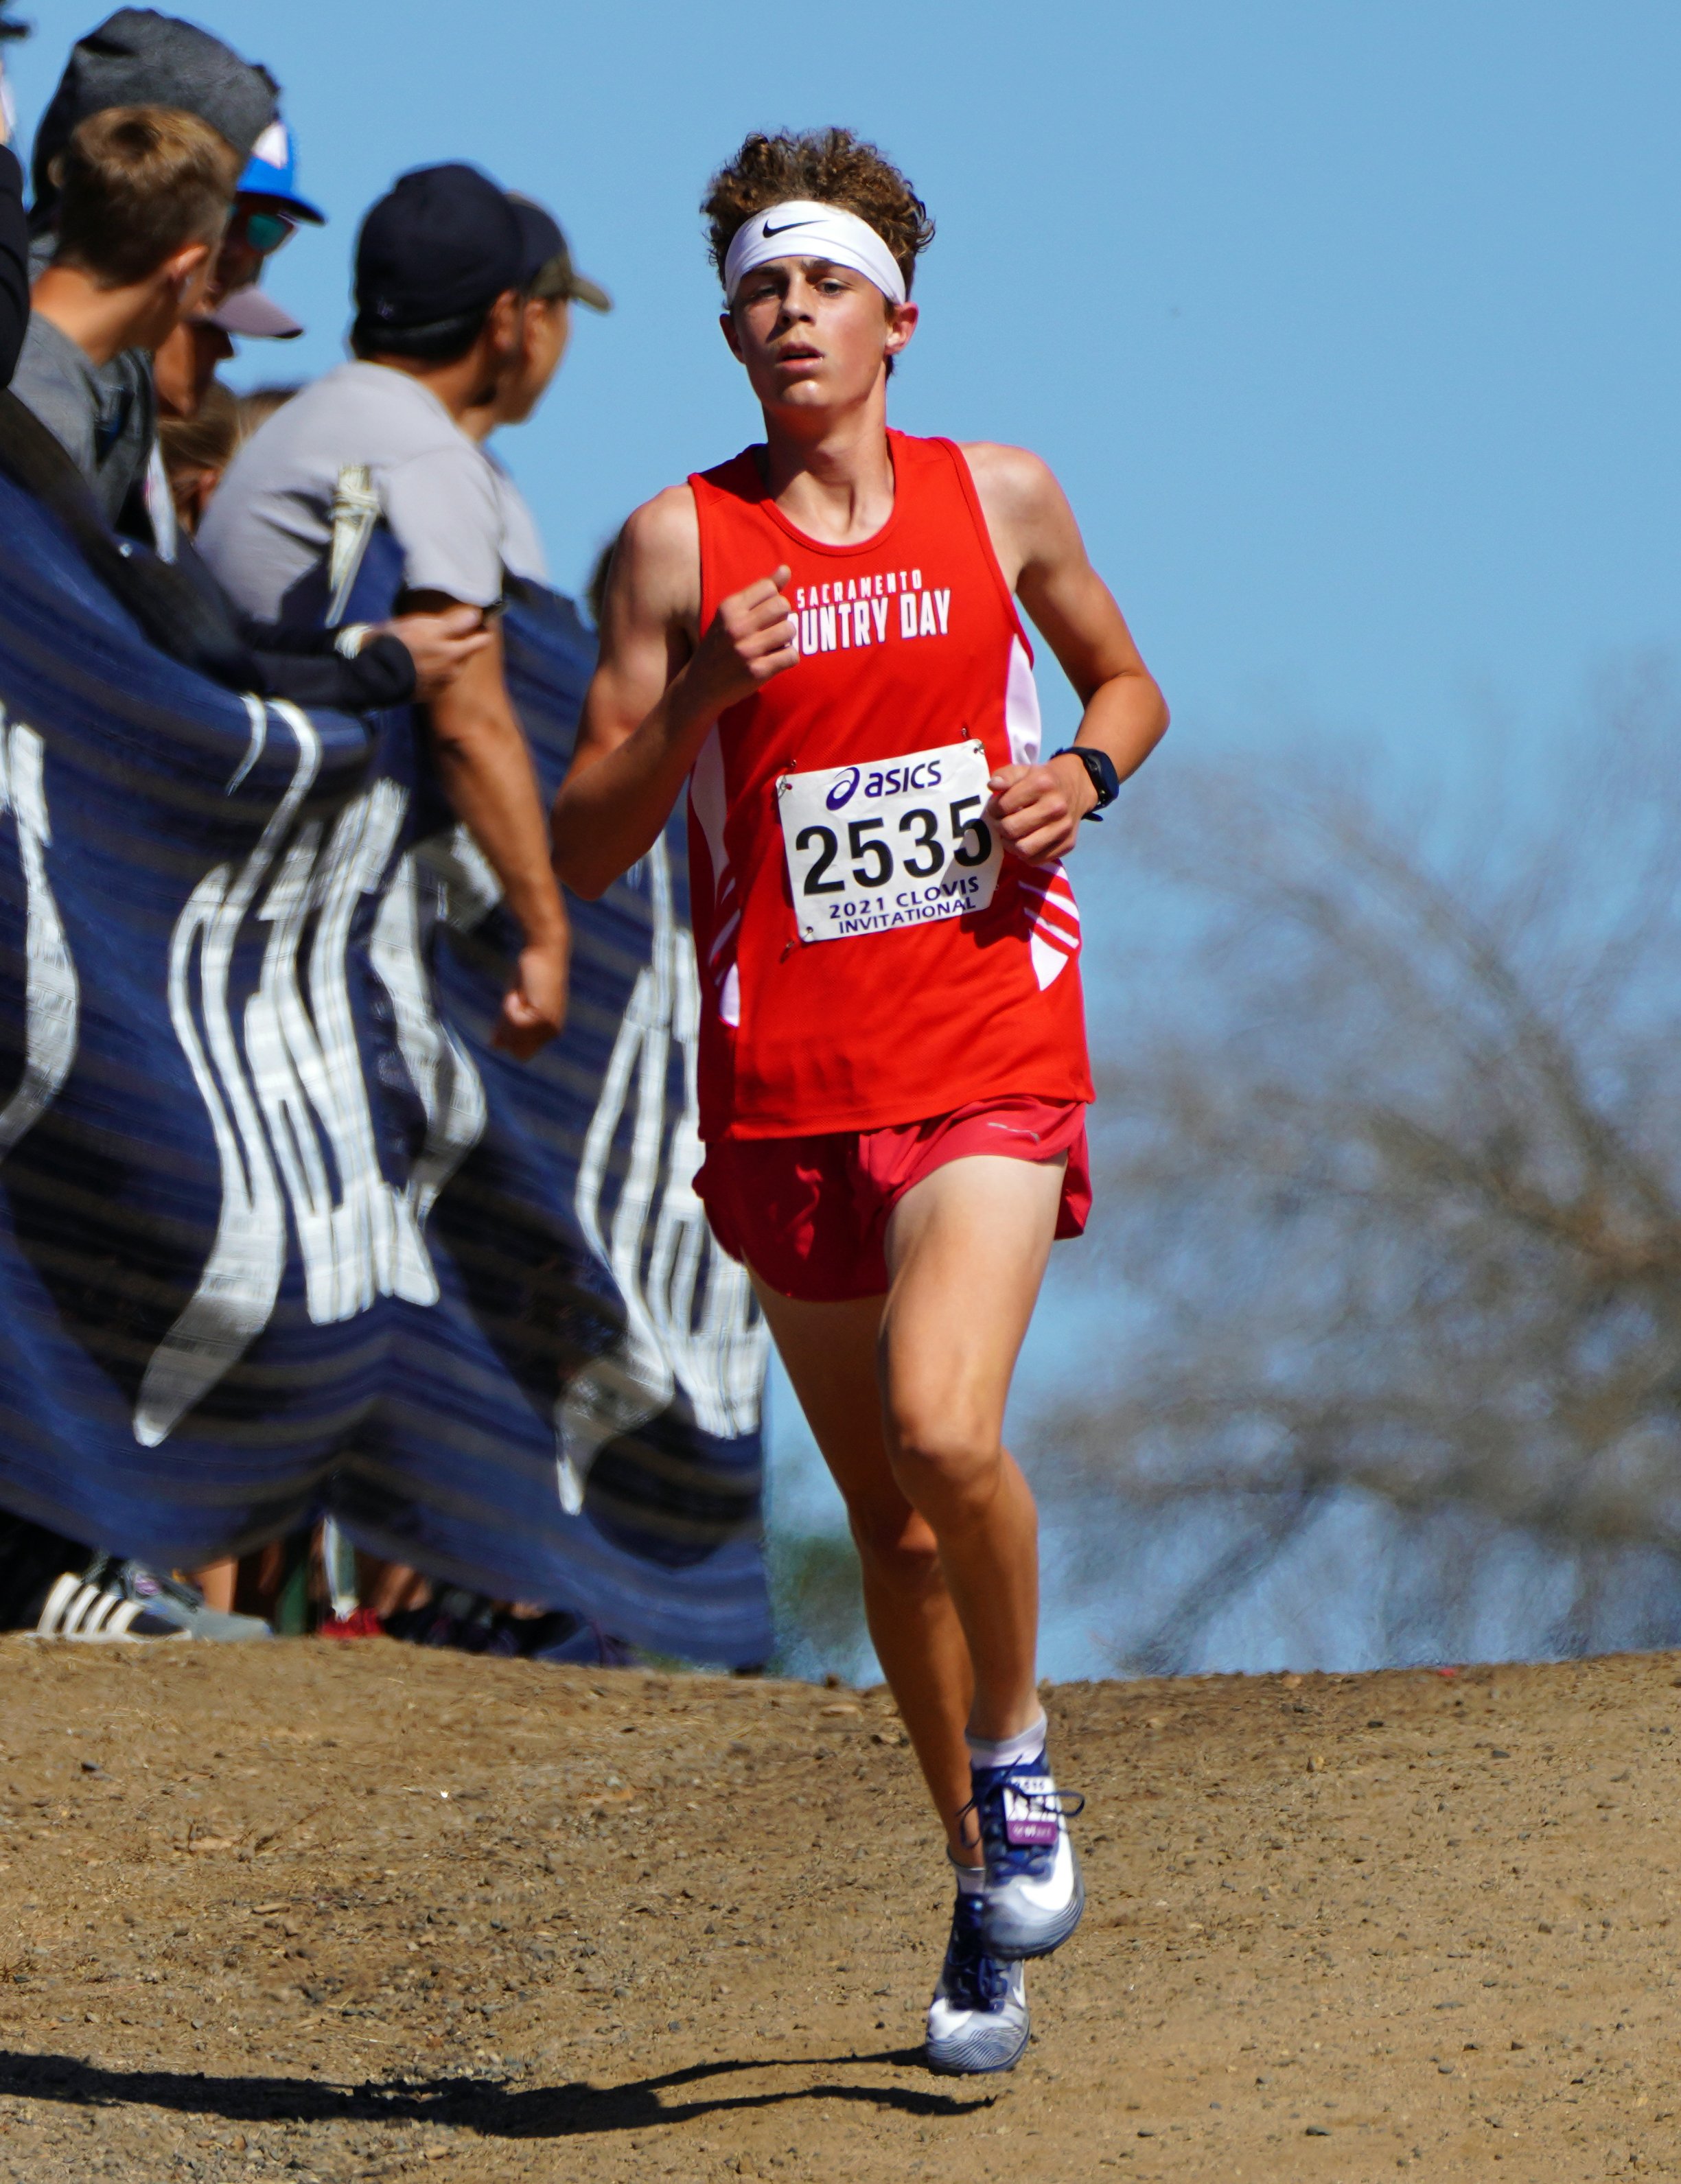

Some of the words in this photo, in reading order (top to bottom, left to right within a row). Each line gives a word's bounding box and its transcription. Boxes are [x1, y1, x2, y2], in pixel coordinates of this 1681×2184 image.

[796, 569, 923, 609] SACRAMENTO
[900, 588, 951, 640] DAY
[865, 759, 942, 798] asics
[795, 795, 993, 896] 2535
[829, 896, 884, 920] 2021
[896, 876, 979, 907] CLOVIS
[839, 896, 977, 934] INVITATIONAL
